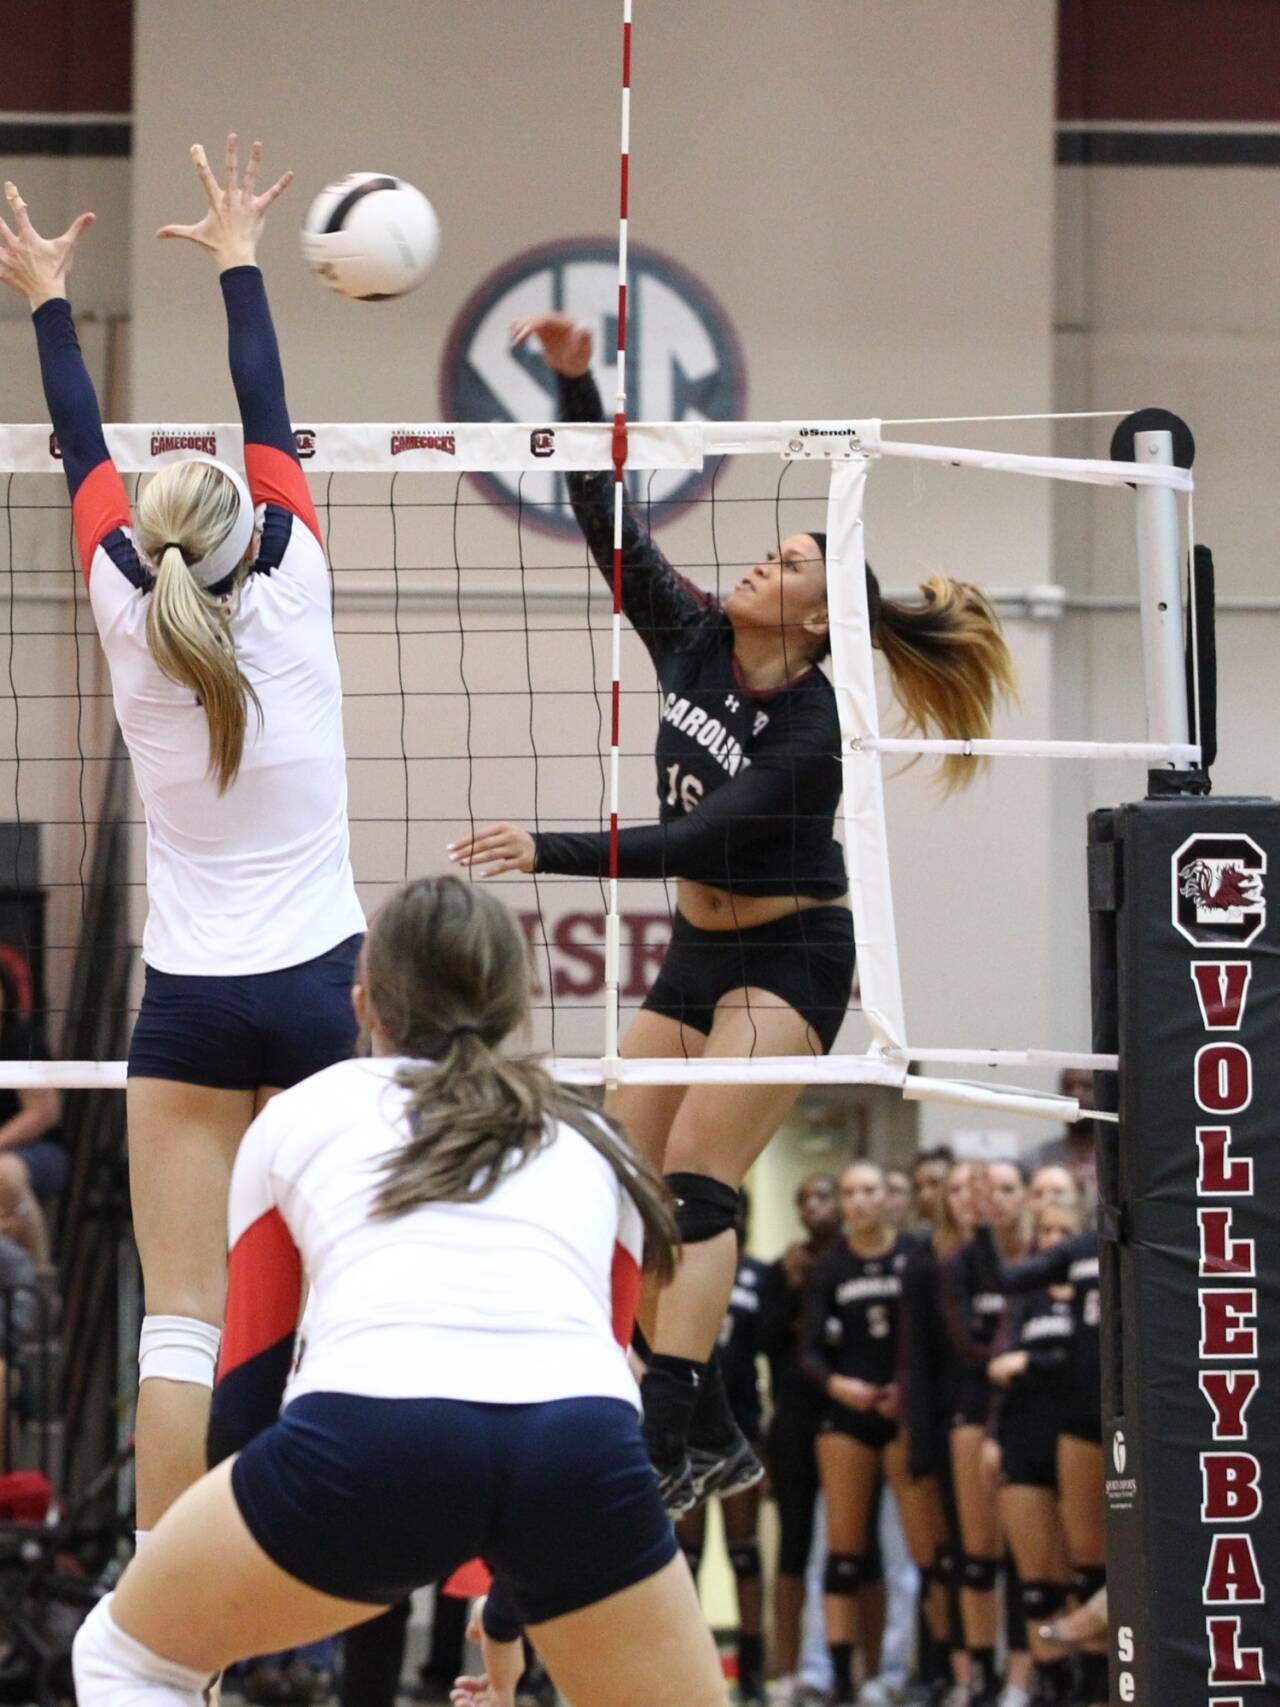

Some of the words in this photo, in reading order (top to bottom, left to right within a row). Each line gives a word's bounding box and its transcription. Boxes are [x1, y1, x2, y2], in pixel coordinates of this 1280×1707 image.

[150, 436, 217, 457] GAMECOCKS
[390, 435, 456, 456] GAMECOCKS
[1189, 960, 1269, 1707] VOLLEYBAL
